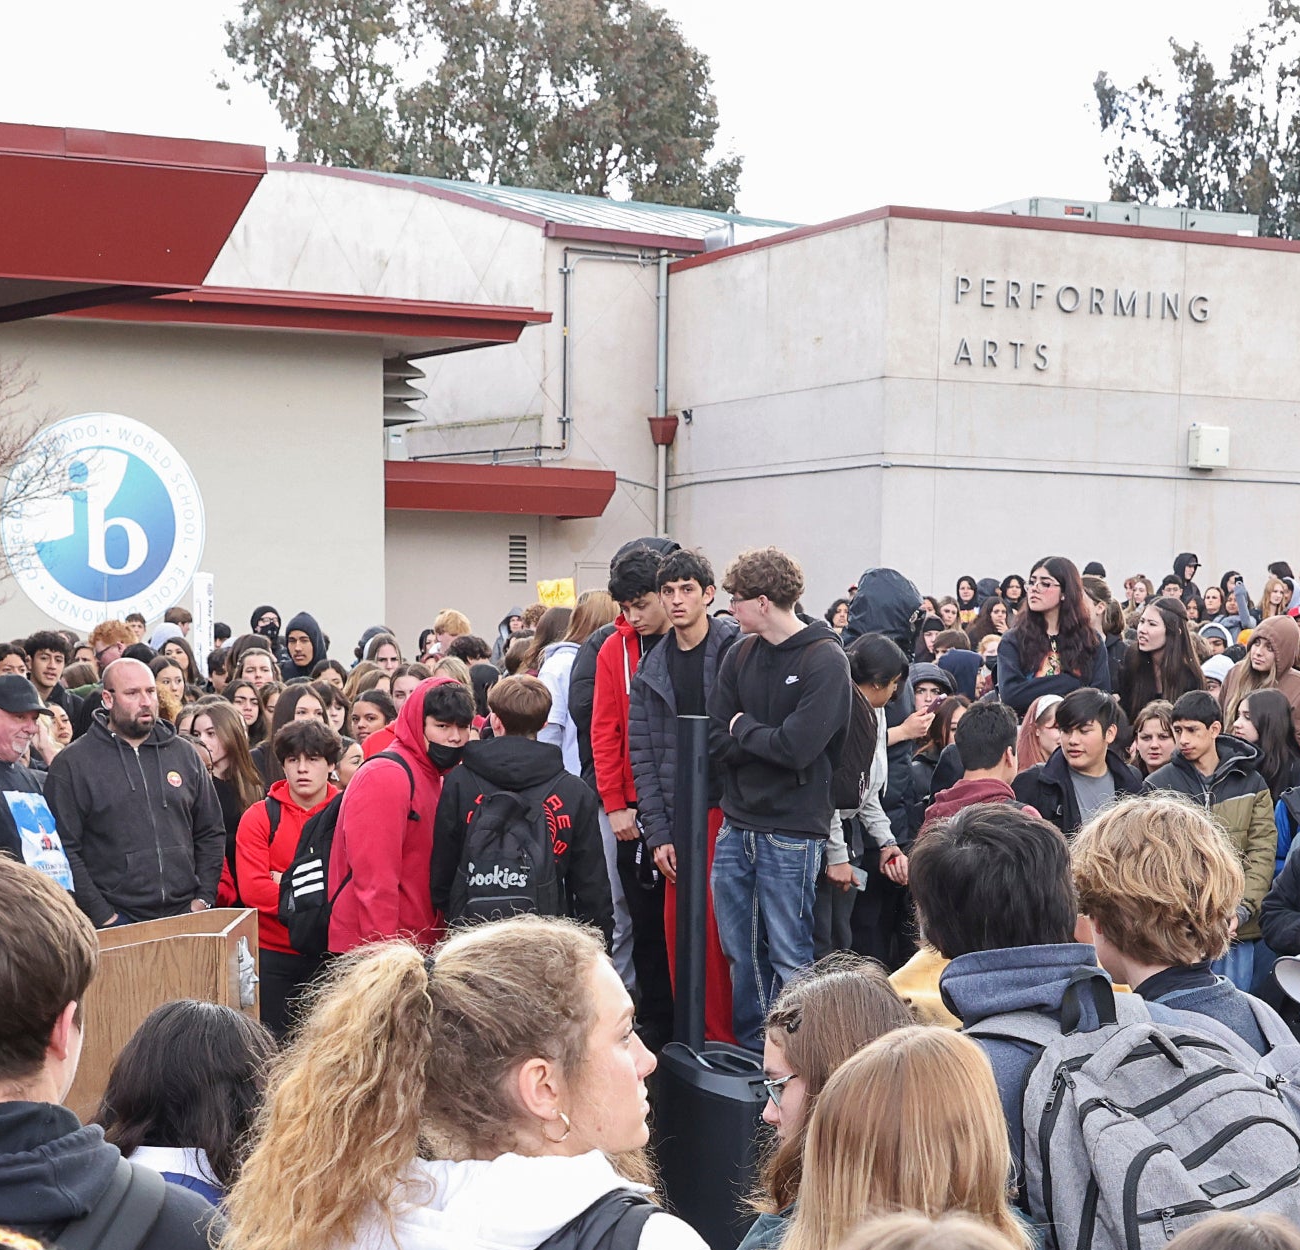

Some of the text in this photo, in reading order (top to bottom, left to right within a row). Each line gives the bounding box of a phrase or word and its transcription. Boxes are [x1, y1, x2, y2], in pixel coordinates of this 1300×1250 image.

[954, 274, 1211, 323] PERFORMING
[953, 337, 1050, 372] ARTS
[118, 426, 196, 544] WORLD SCHOOL
[47, 590, 107, 623] MONDE
